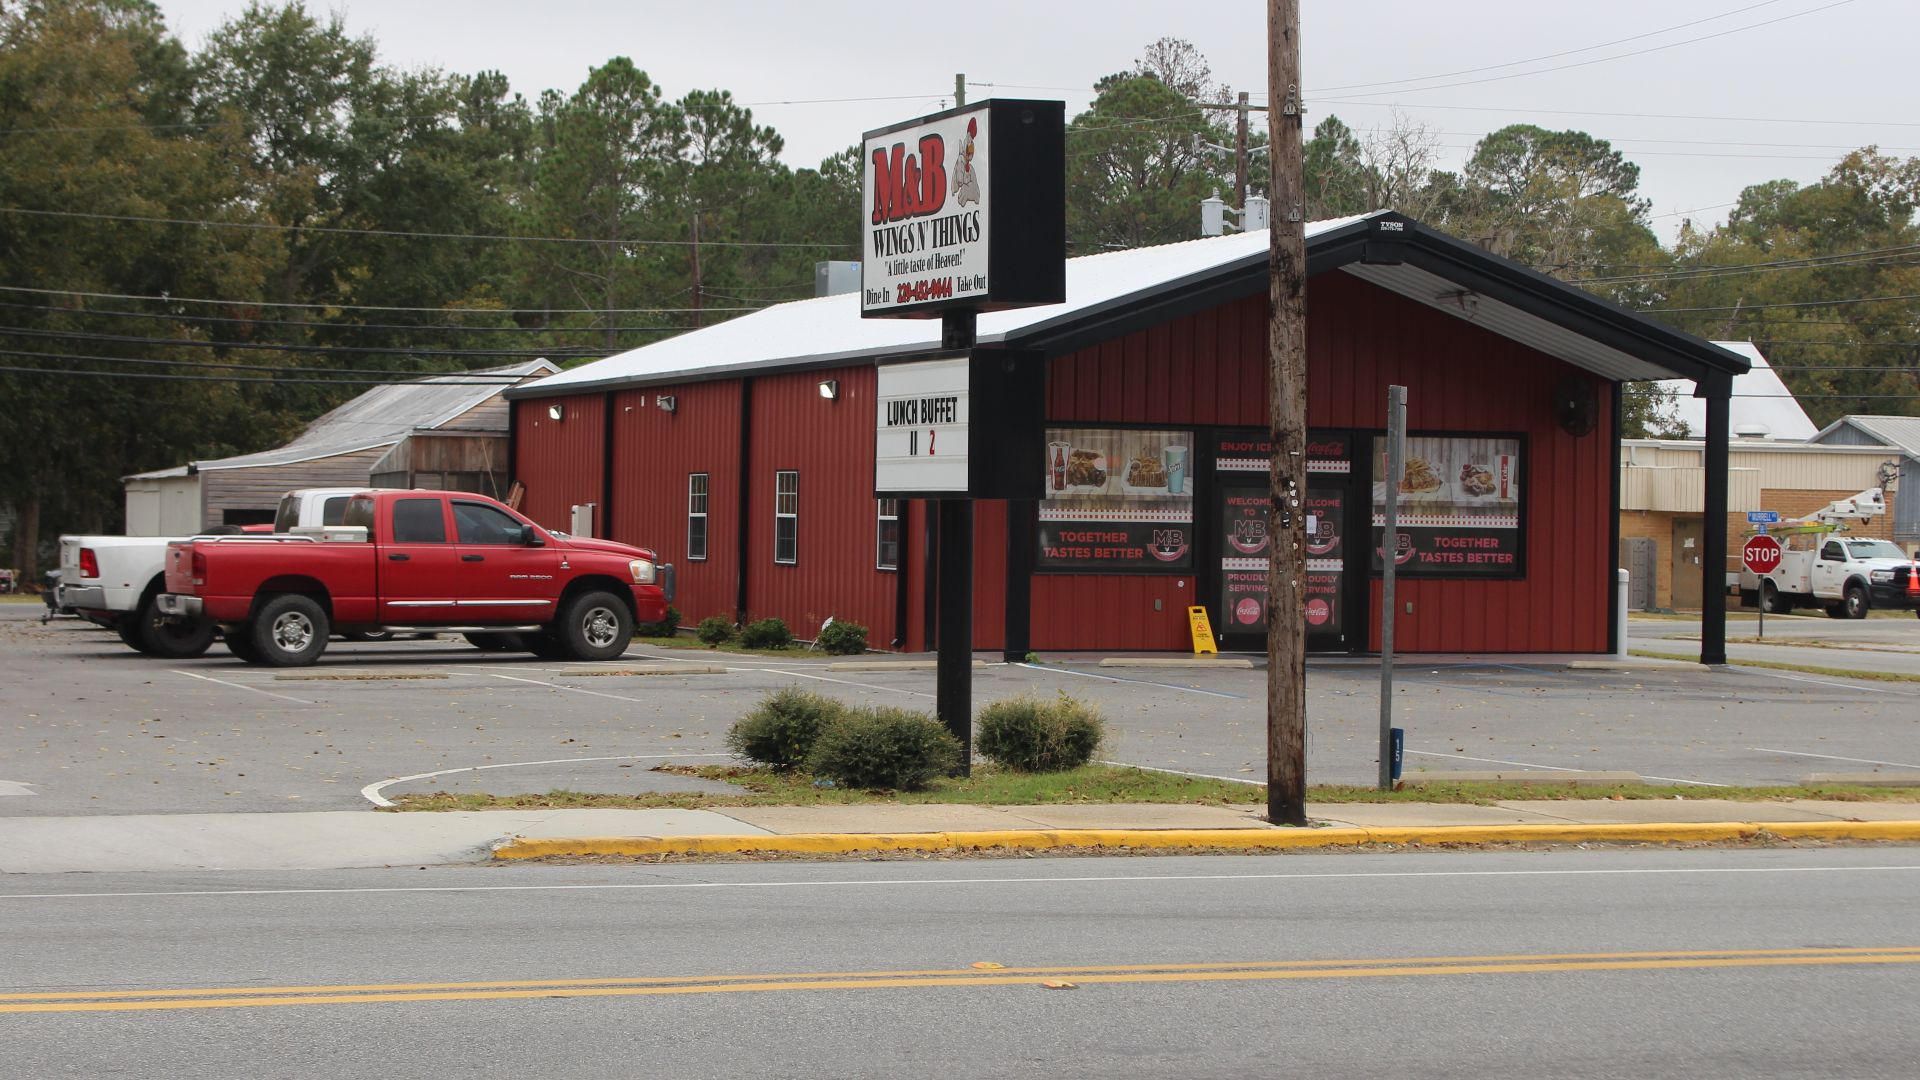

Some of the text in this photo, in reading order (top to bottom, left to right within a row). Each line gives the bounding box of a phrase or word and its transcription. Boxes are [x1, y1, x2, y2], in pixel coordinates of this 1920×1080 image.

[872, 133, 947, 225] M&B
[873, 222, 915, 258] WINGS
[931, 210, 980, 247] THINGS
[893, 259, 909, 275] little
[910, 259, 925, 274] taste
[927, 254, 934, 271] of
[956, 273, 987, 293] Take Out
[866, 287, 890, 305] Dine In
[887, 397, 958, 426] LUNCH BUFFET
[929, 429, 936, 455] 2
[1221, 442, 1255, 451] ENJOY
[1227, 497, 1272, 506] WELCOME
[1306, 498, 1341, 507] ELCOME
[1311, 509, 1325, 518] TO
[1059, 531, 1128, 543] TOGETHER
[1434, 537, 1500, 549] TOGETHER
[1043, 547, 1144, 559] TASTES BETTER
[1419, 552, 1513, 564] TASTES BETTER
[1745, 548, 1780, 562] STOP
[1227, 573, 1269, 581] PROUDLY
[1307, 575, 1338, 583] OUDLY
[1228, 584, 1269, 592] SERVING
